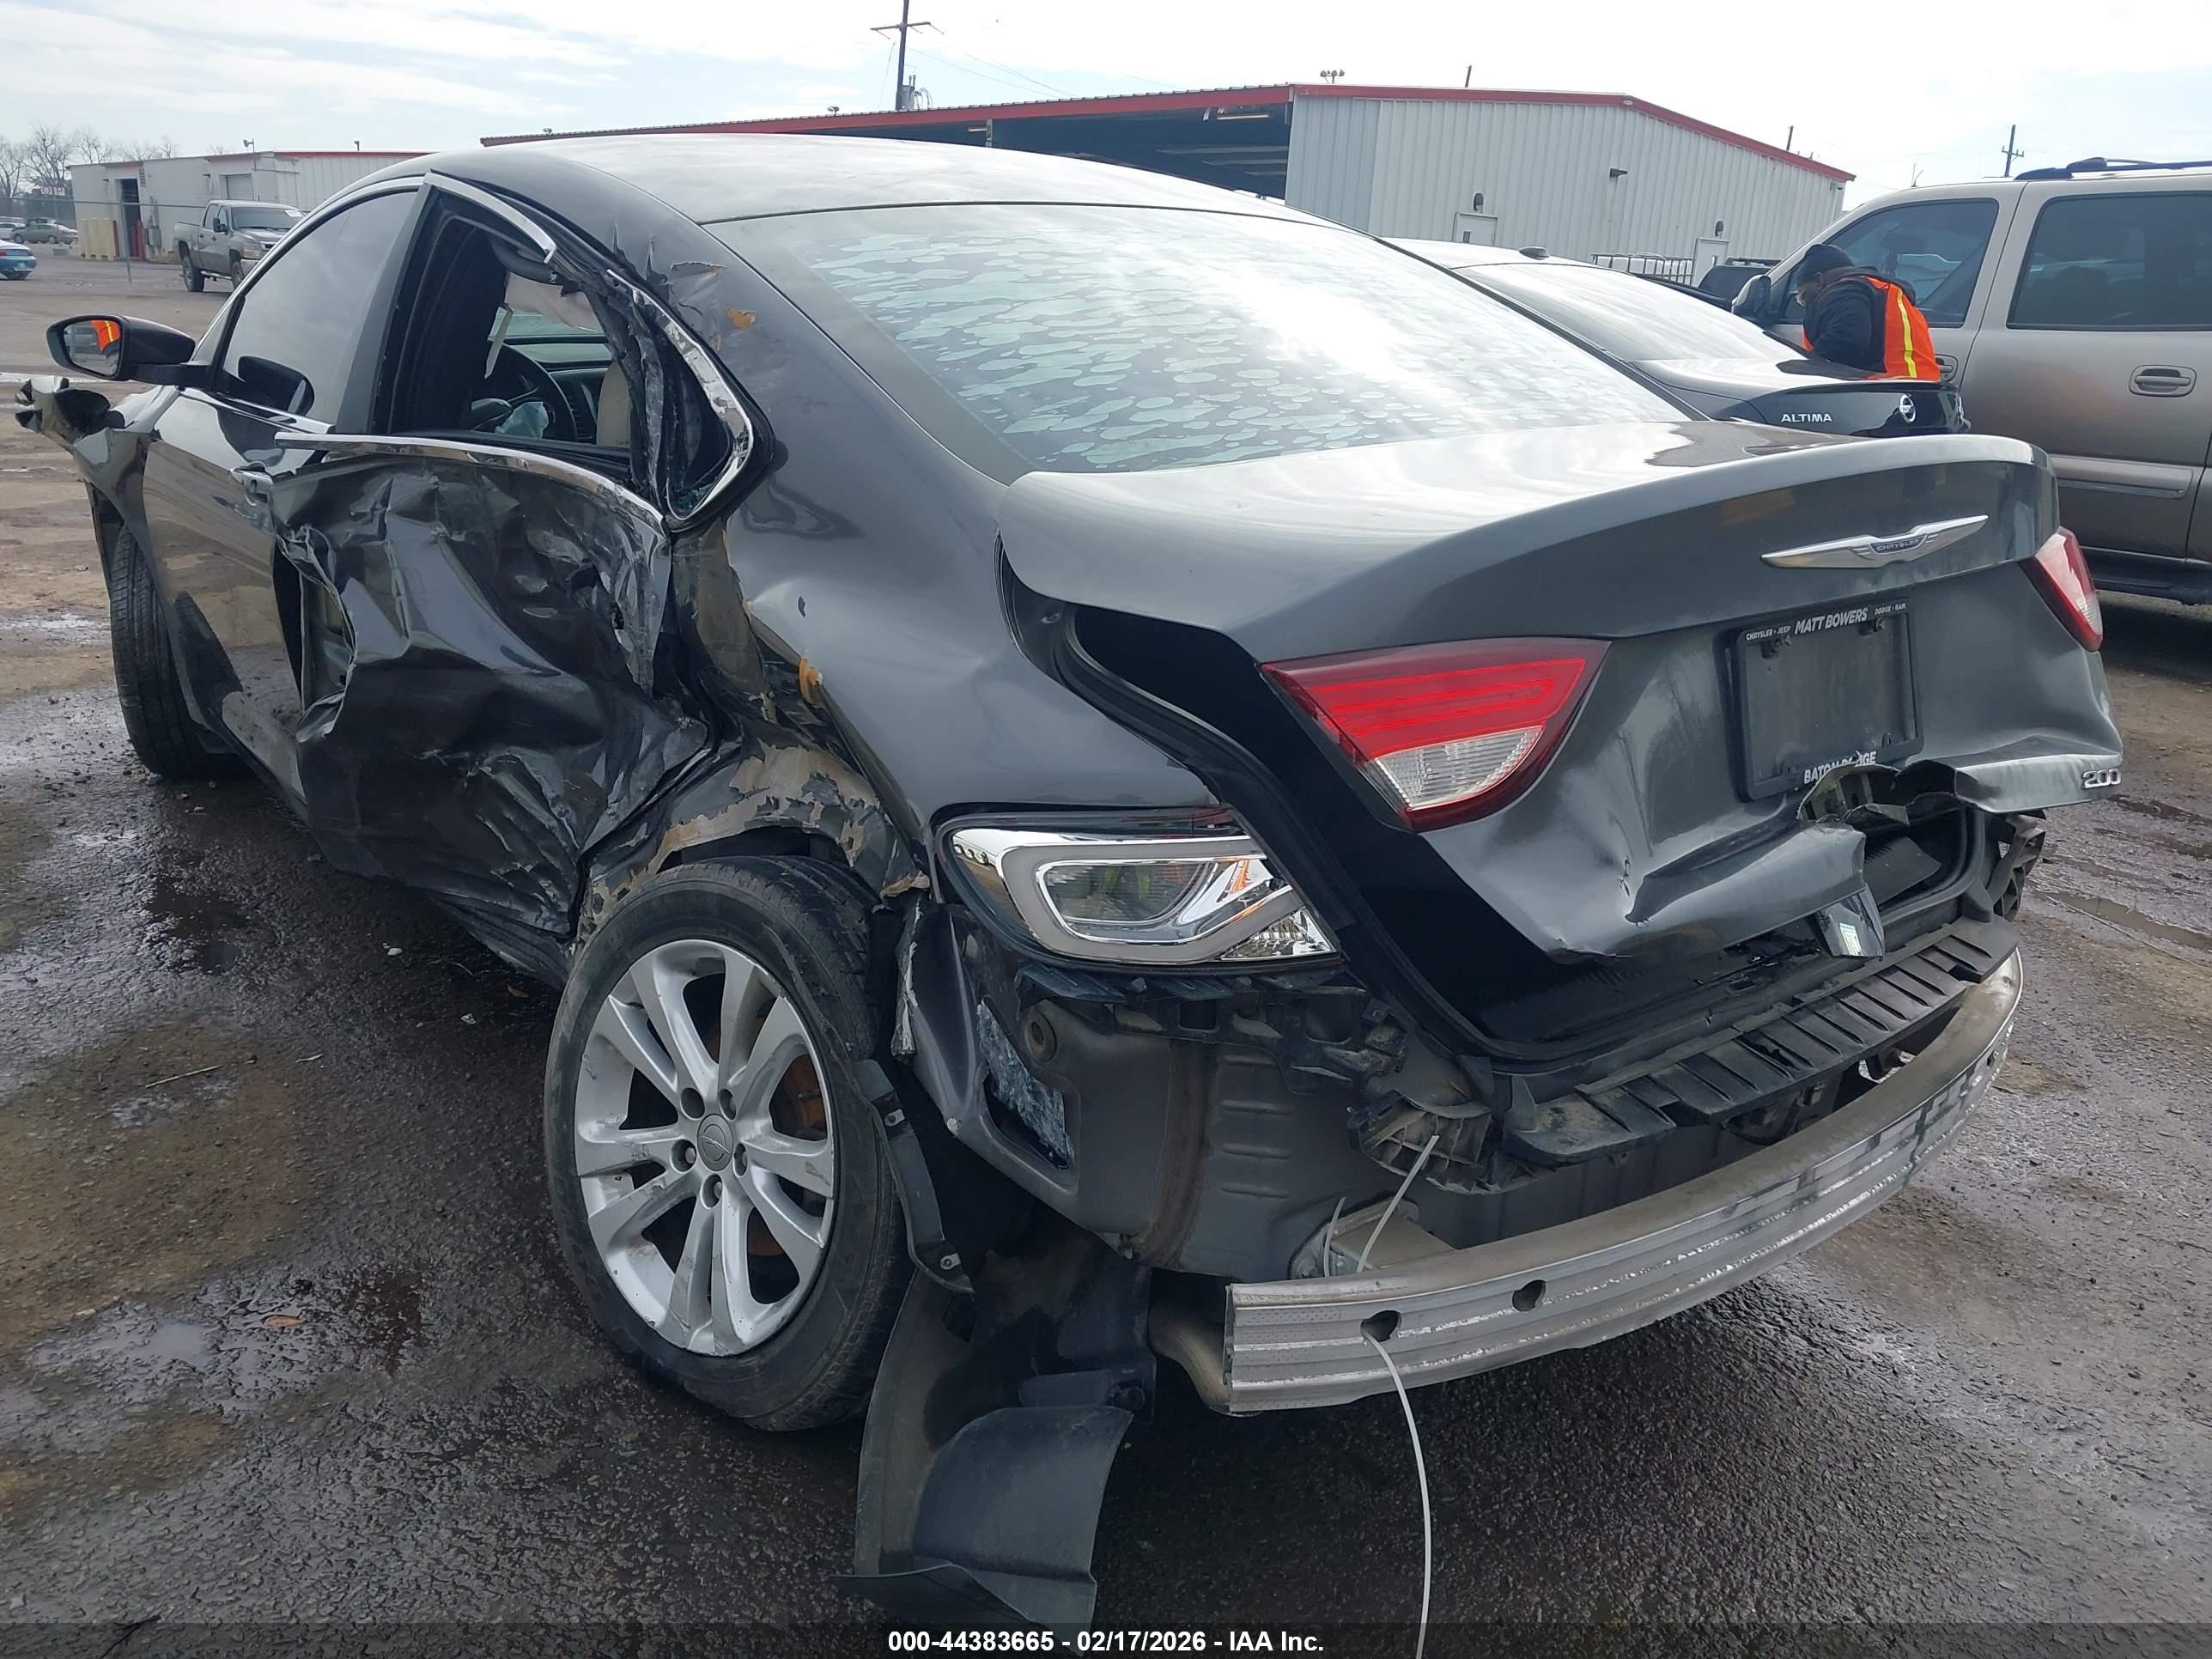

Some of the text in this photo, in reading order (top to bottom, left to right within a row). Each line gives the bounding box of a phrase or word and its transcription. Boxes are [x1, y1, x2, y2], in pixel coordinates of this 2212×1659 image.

[1780, 413, 1832, 422] ALTIMA
[1876, 538, 1919, 551] CHRYSLER
[1746, 629, 1773, 641] CHRYSLER
[1777, 625, 1791, 635] JEEP
[1794, 615, 1826, 635] MATT
[1825, 608, 1868, 629] BOWERS
[2084, 769, 2121, 788] 200
